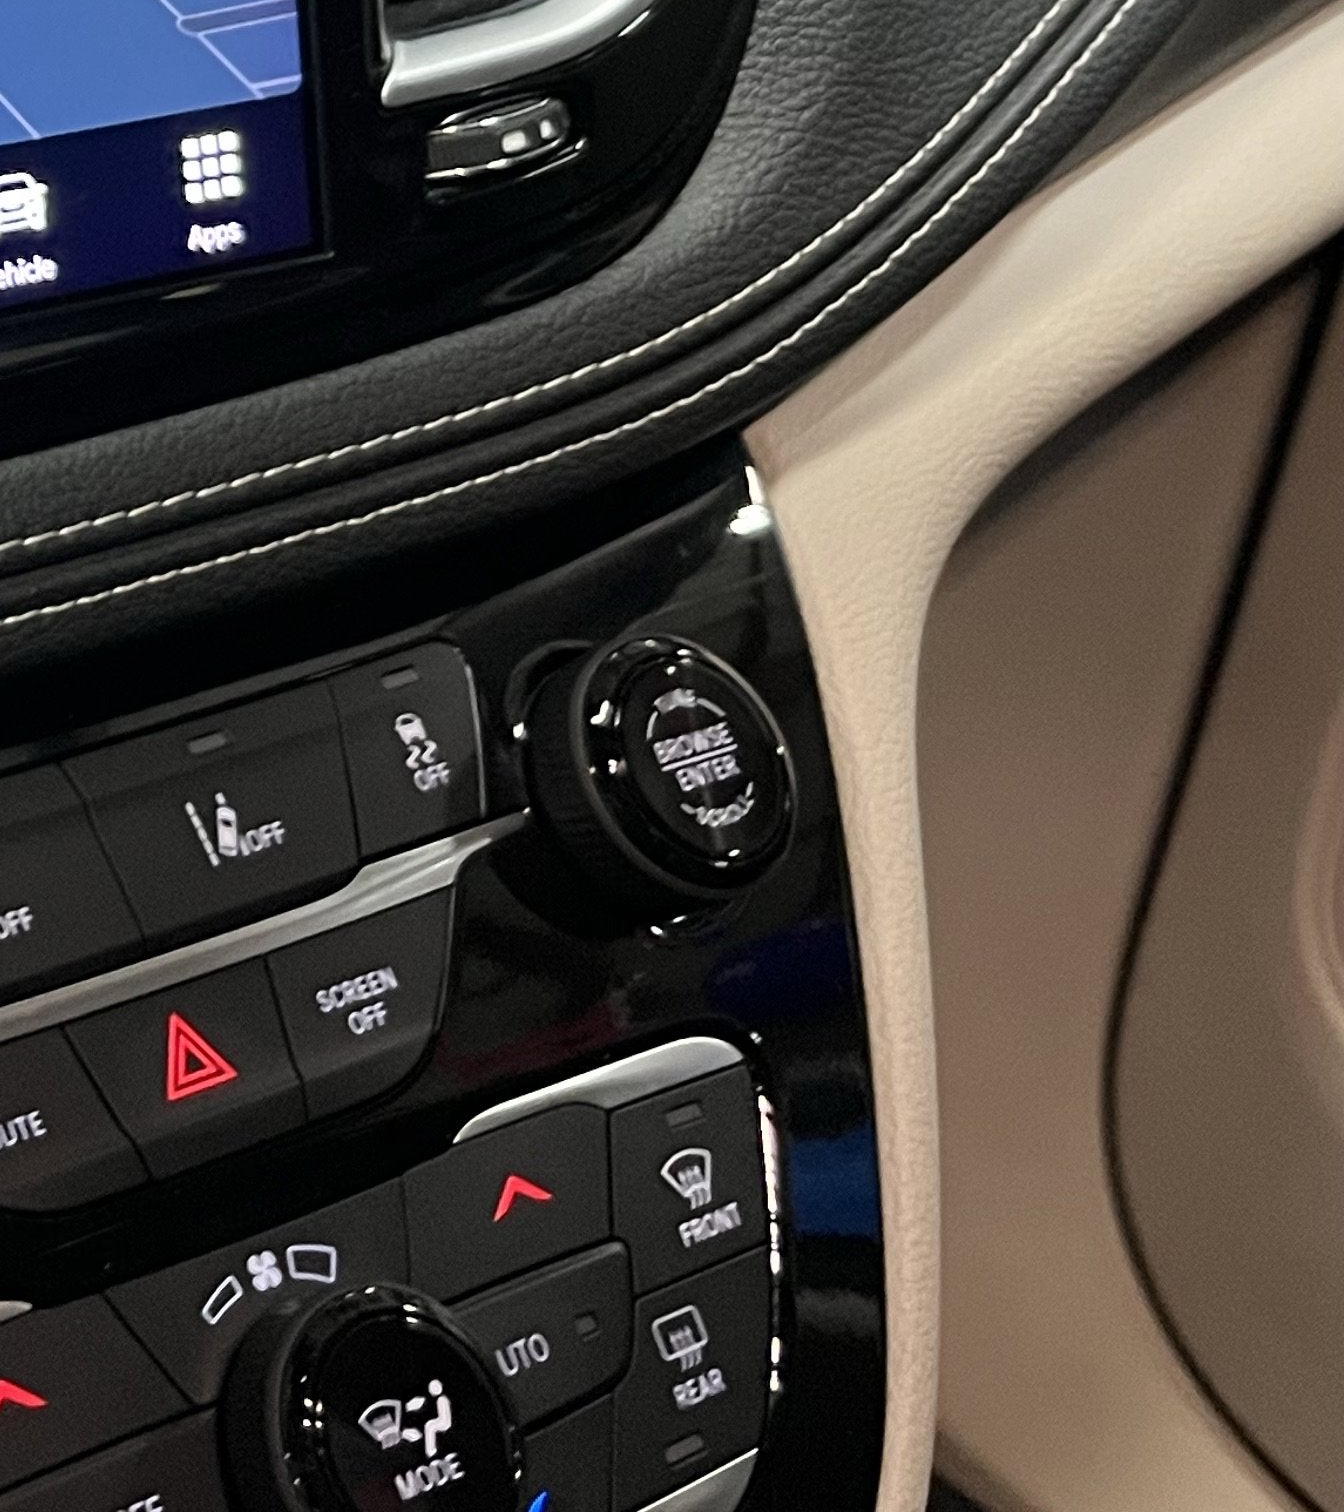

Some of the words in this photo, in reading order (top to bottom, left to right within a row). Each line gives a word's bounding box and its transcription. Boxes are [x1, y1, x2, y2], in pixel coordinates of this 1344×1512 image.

[188, 221, 244, 253] Apps
[315, 966, 398, 1013] SCREEN
[348, 1001, 387, 1035] OFF
[394, 1451, 465, 1501] MODE
